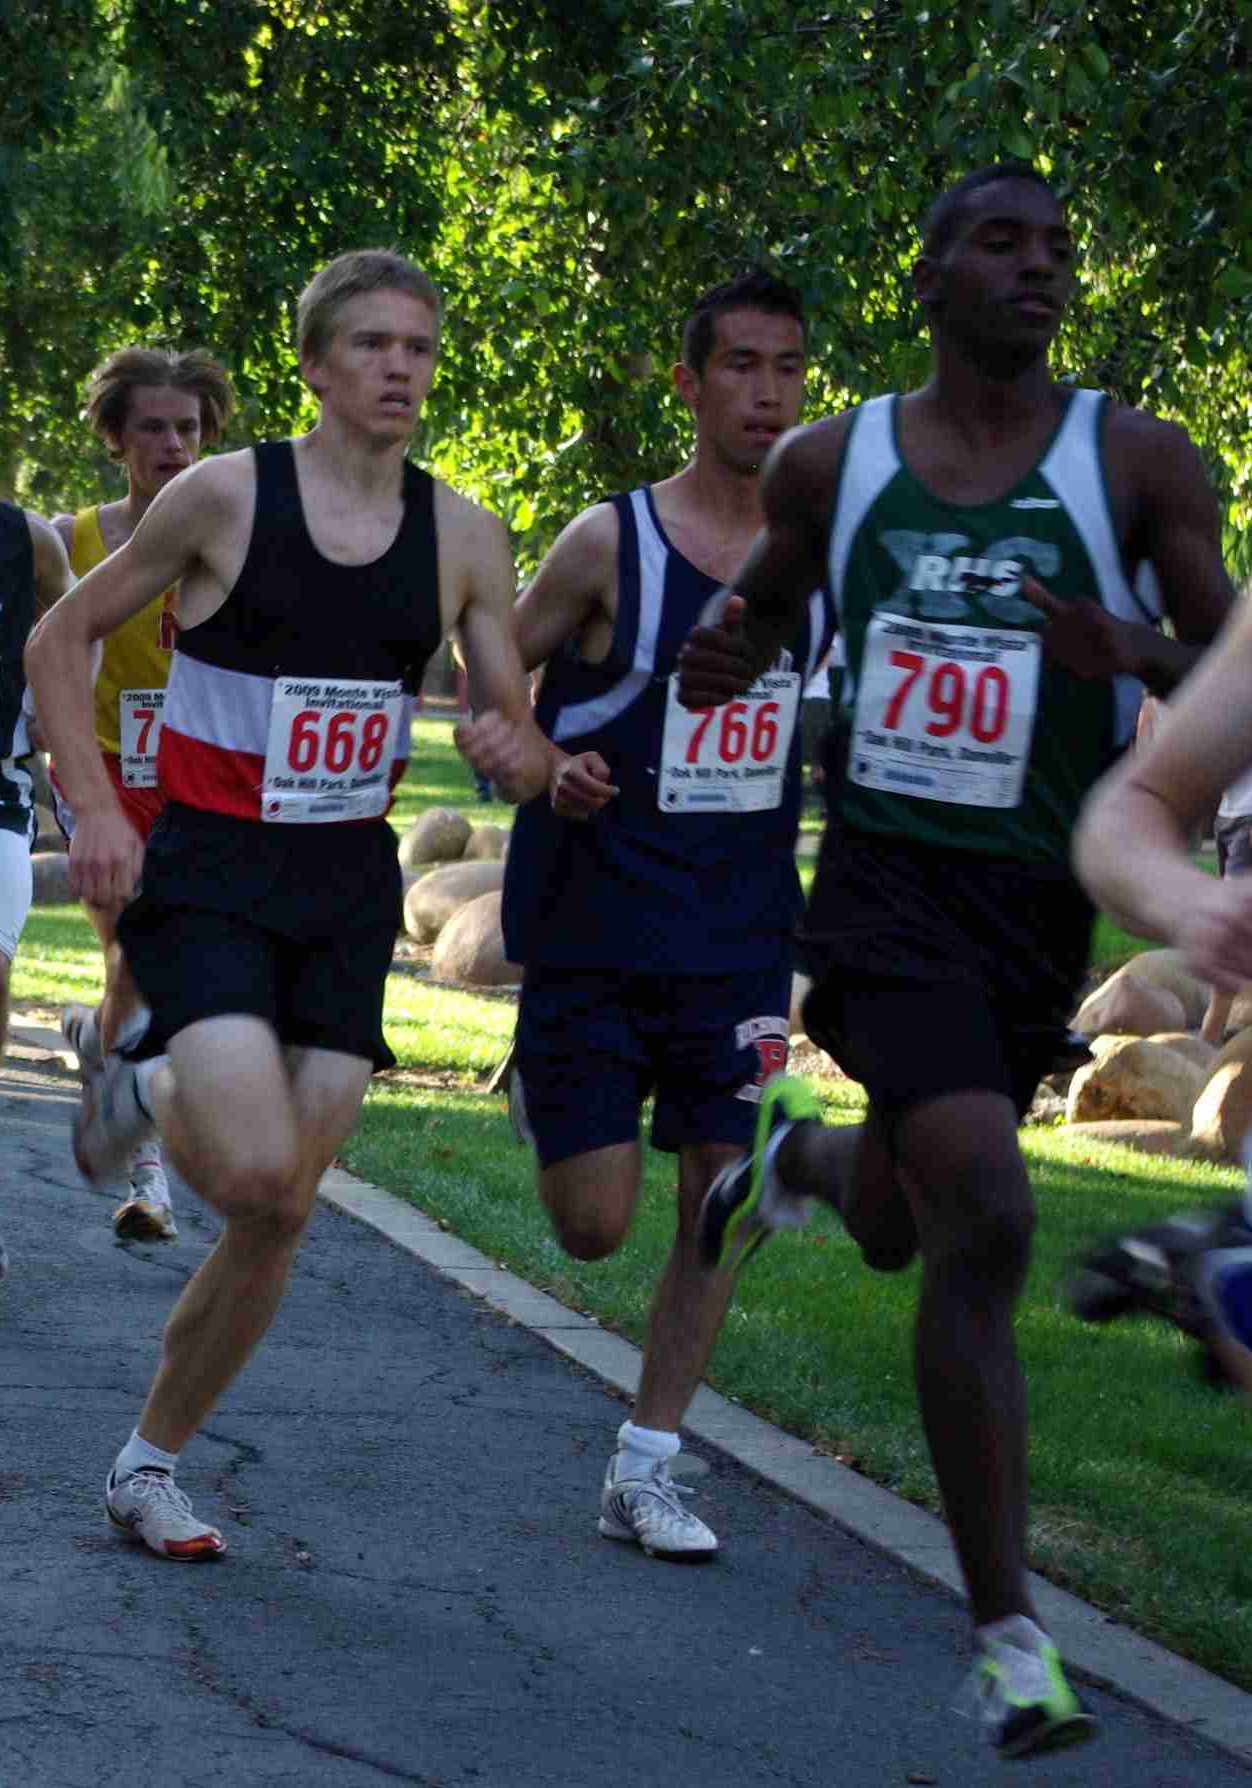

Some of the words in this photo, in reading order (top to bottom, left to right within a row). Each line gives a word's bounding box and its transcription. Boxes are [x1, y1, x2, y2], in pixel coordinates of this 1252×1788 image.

[285, 684, 321, 696] 2009
[324, 686, 367, 698] Monte
[881, 650, 1010, 743] 790
[287, 710, 389, 773] 668
[685, 702, 780, 764] 766
